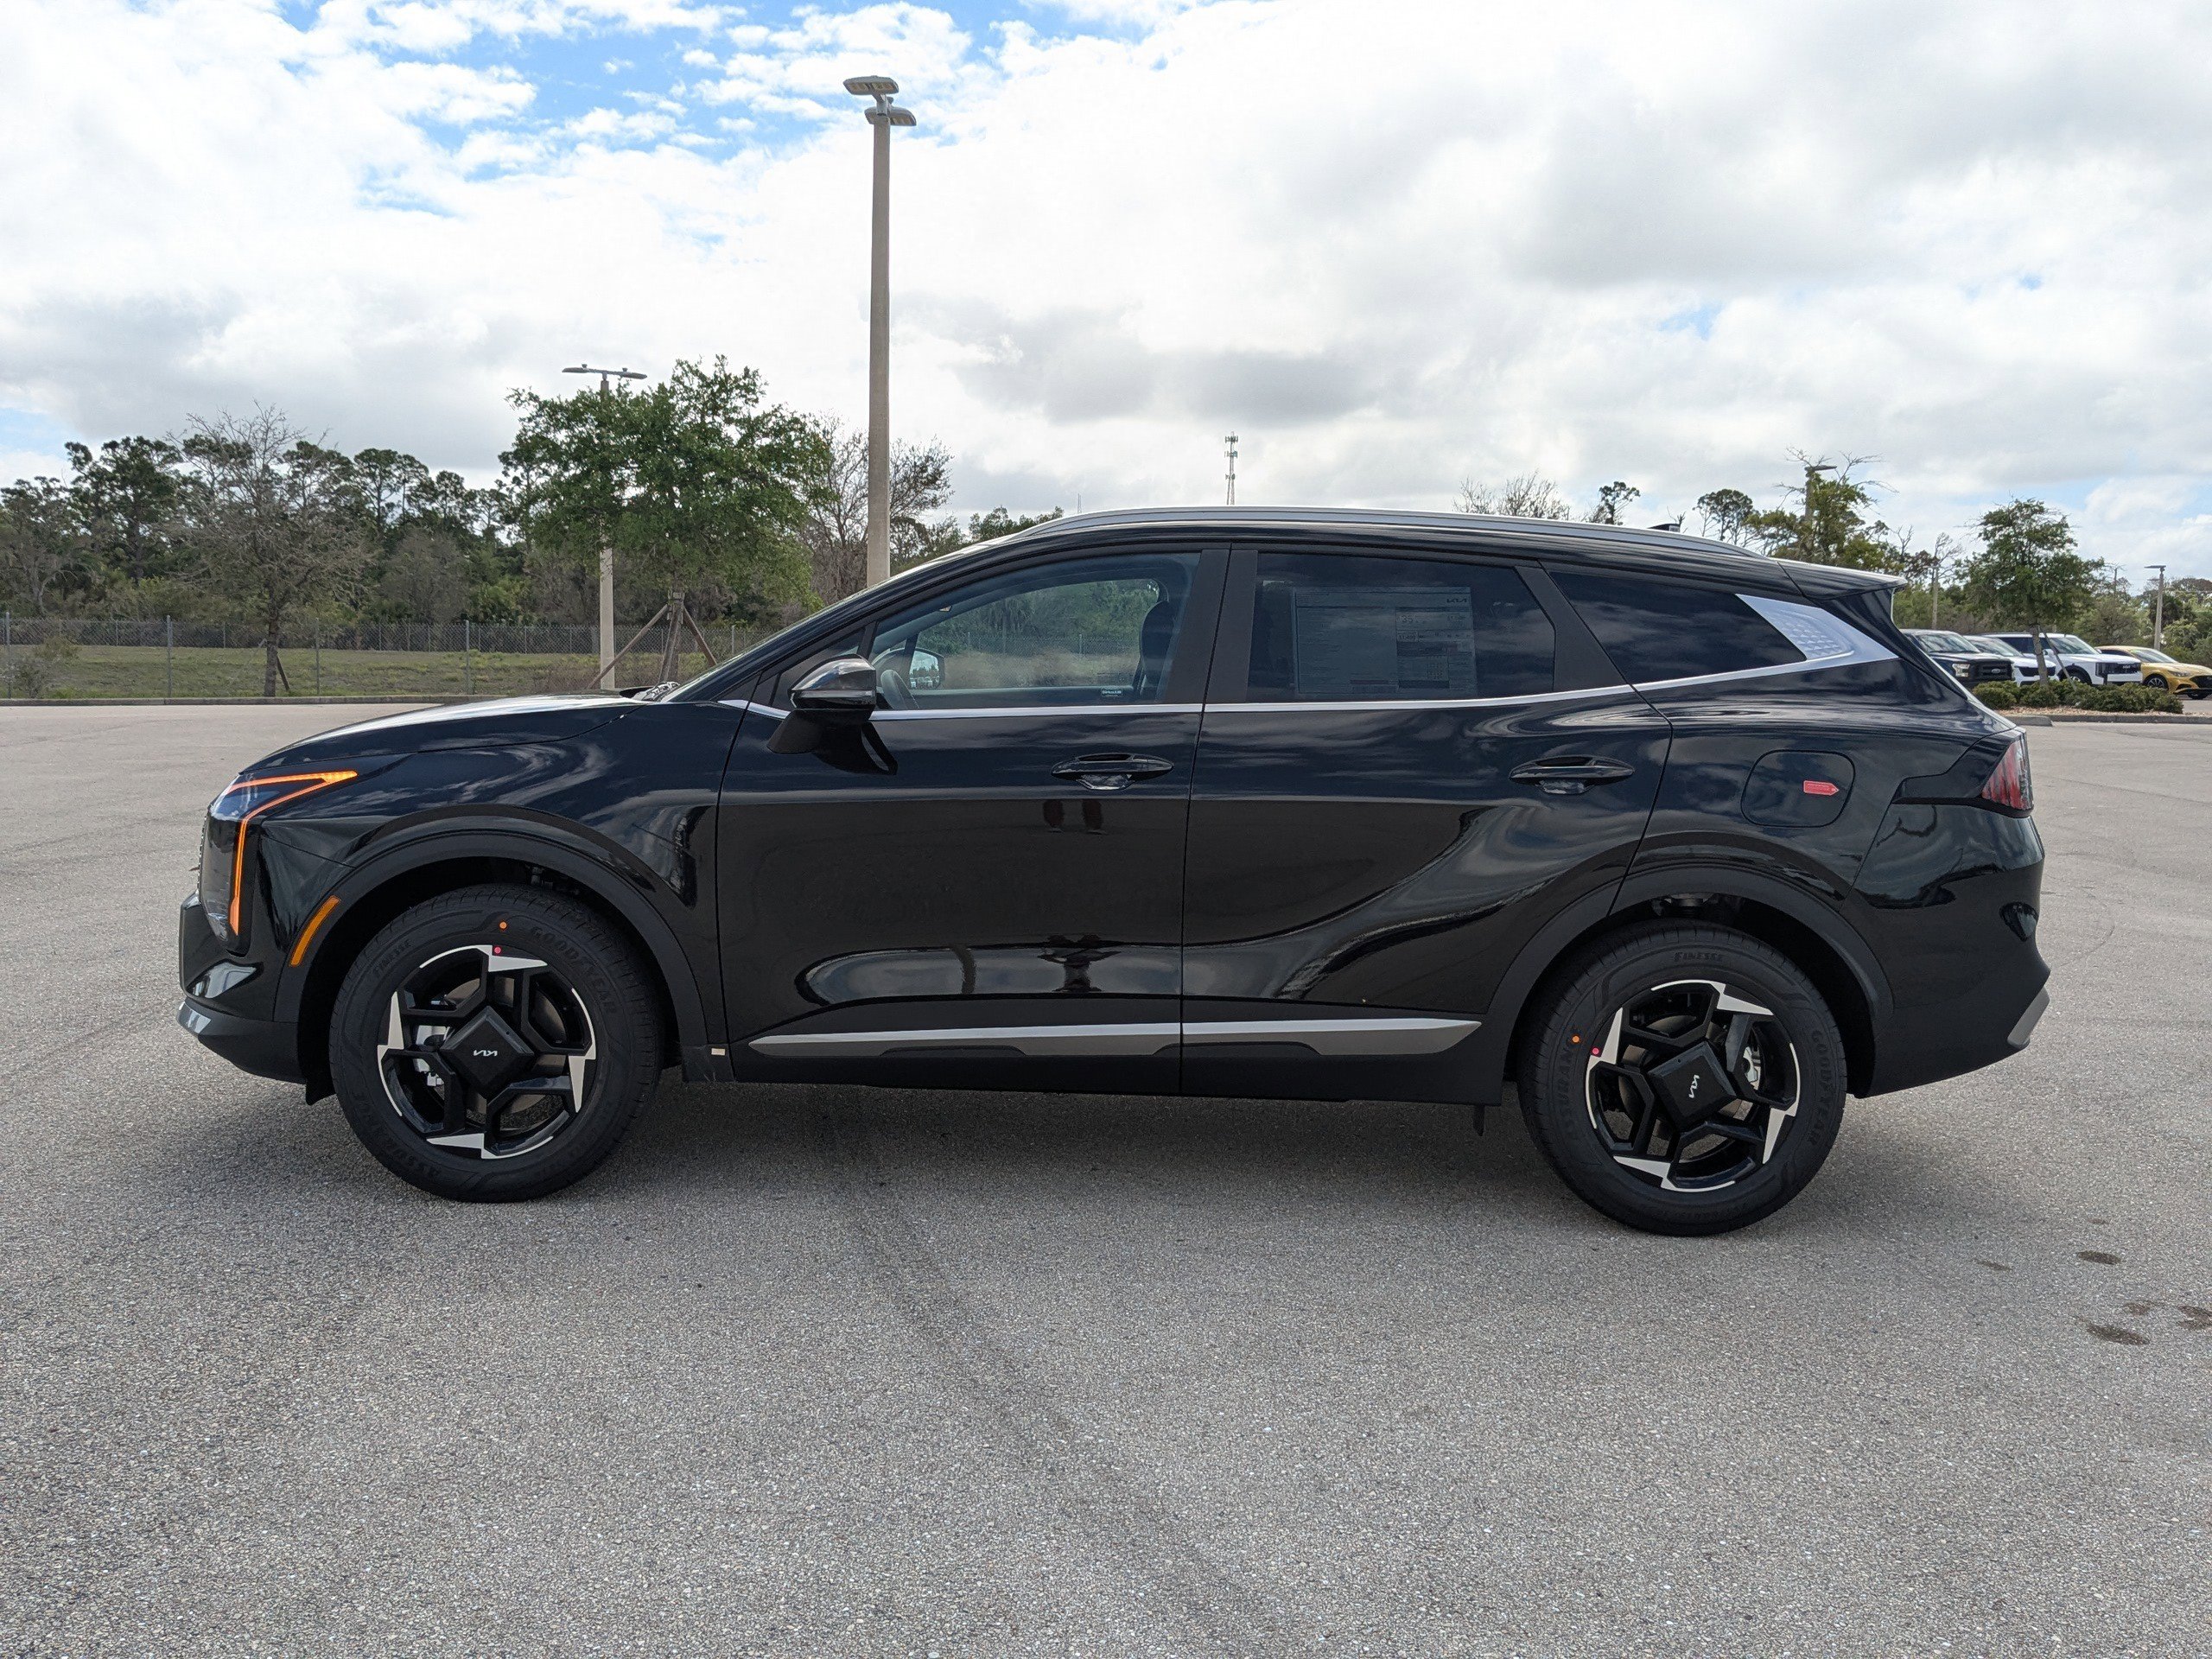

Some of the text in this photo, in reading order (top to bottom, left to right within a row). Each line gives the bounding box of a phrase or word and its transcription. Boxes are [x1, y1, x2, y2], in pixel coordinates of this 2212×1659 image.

[531, 925, 617, 1015] GOODYEAR
[1674, 951, 1725, 963] FINESSE
[1688, 1074, 1700, 1098] KIA
[1807, 1030, 1832, 1147] GOODYEAR
